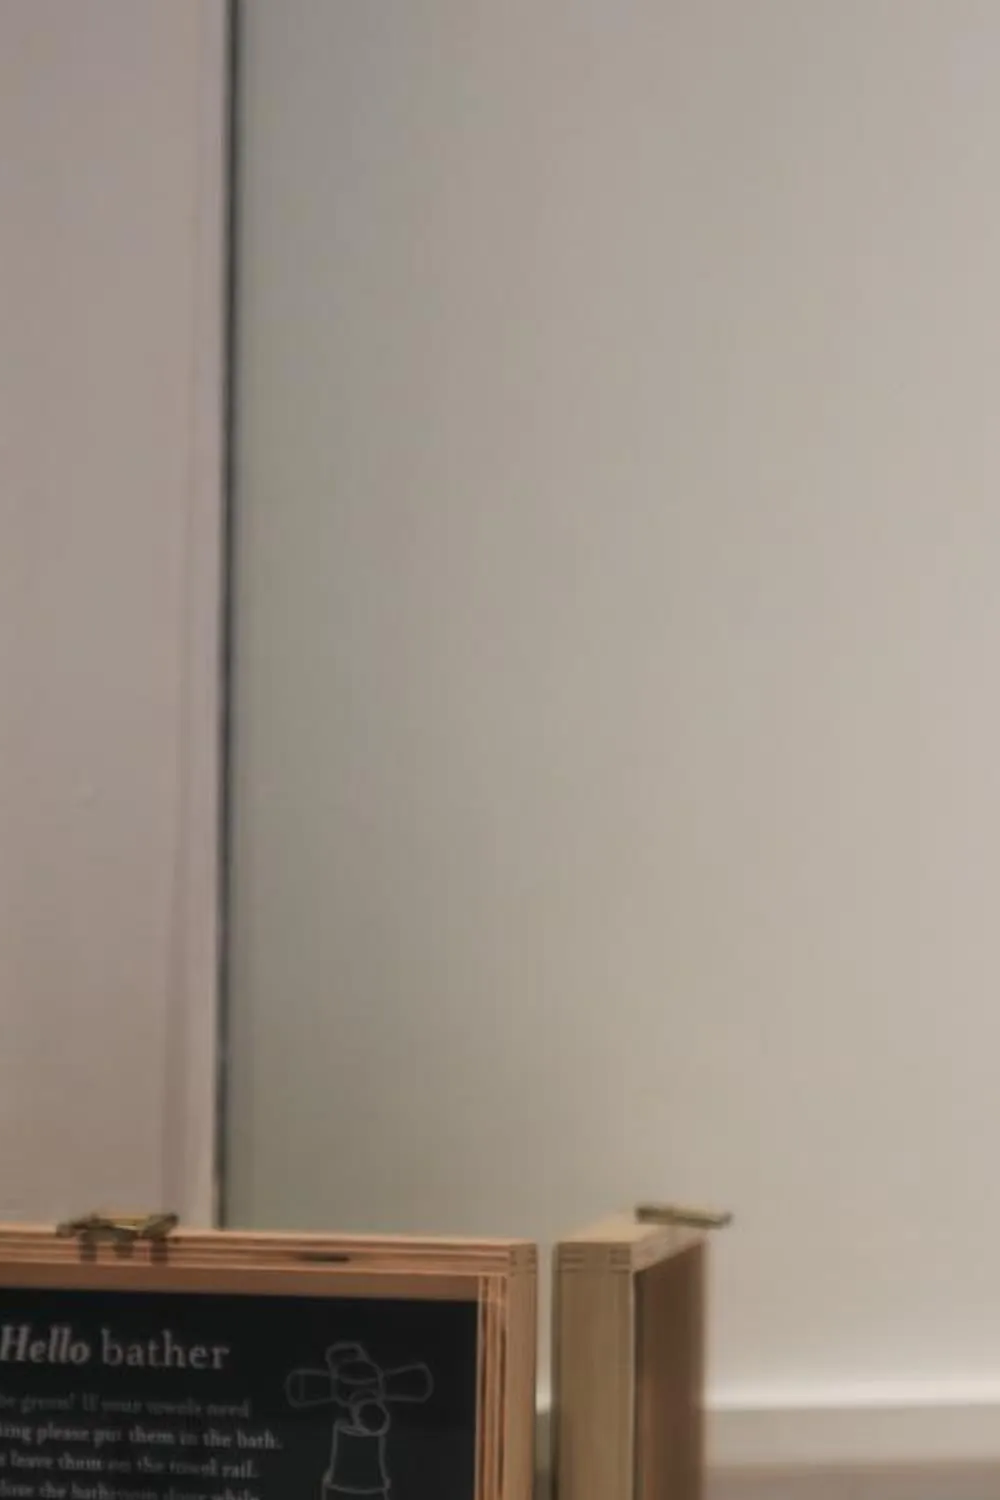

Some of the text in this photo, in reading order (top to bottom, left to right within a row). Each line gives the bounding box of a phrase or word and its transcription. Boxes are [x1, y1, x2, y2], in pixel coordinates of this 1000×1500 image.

[100, 1327, 230, 1370] bather
[36, 1420, 90, 1446] please
[93, 1426, 122, 1449] put
[127, 1424, 176, 1446] them
[179, 1430, 199, 1446] in
[202, 1426, 233, 1448] the
[9, 1447, 54, 1469] leave
[57, 1451, 104, 1472] them
[136, 1455, 166, 1474] the
[38, 1479, 67, 1500] the
